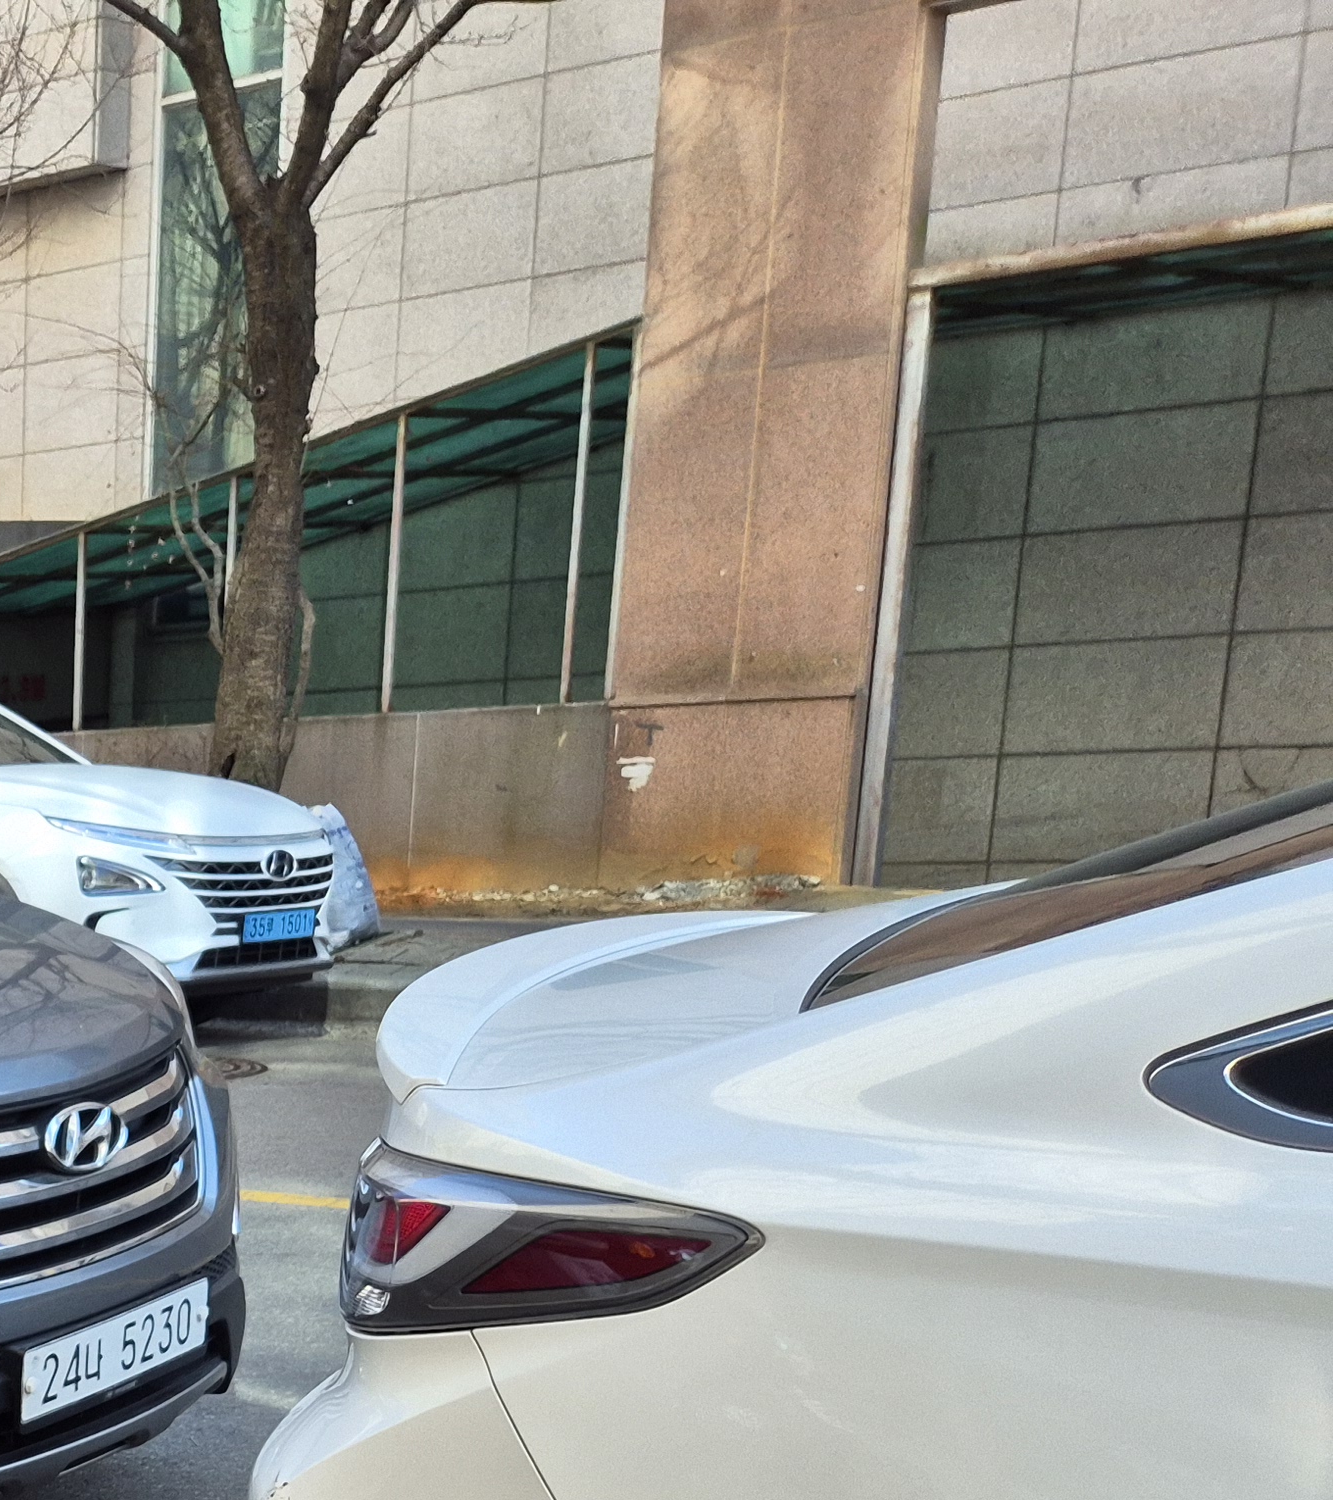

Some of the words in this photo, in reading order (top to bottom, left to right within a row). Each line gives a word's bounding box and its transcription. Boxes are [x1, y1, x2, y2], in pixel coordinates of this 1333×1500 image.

[281, 912, 308, 936] 1501
[42, 1338, 104, 1405] 24나
[121, 1298, 191, 1371] 5230
